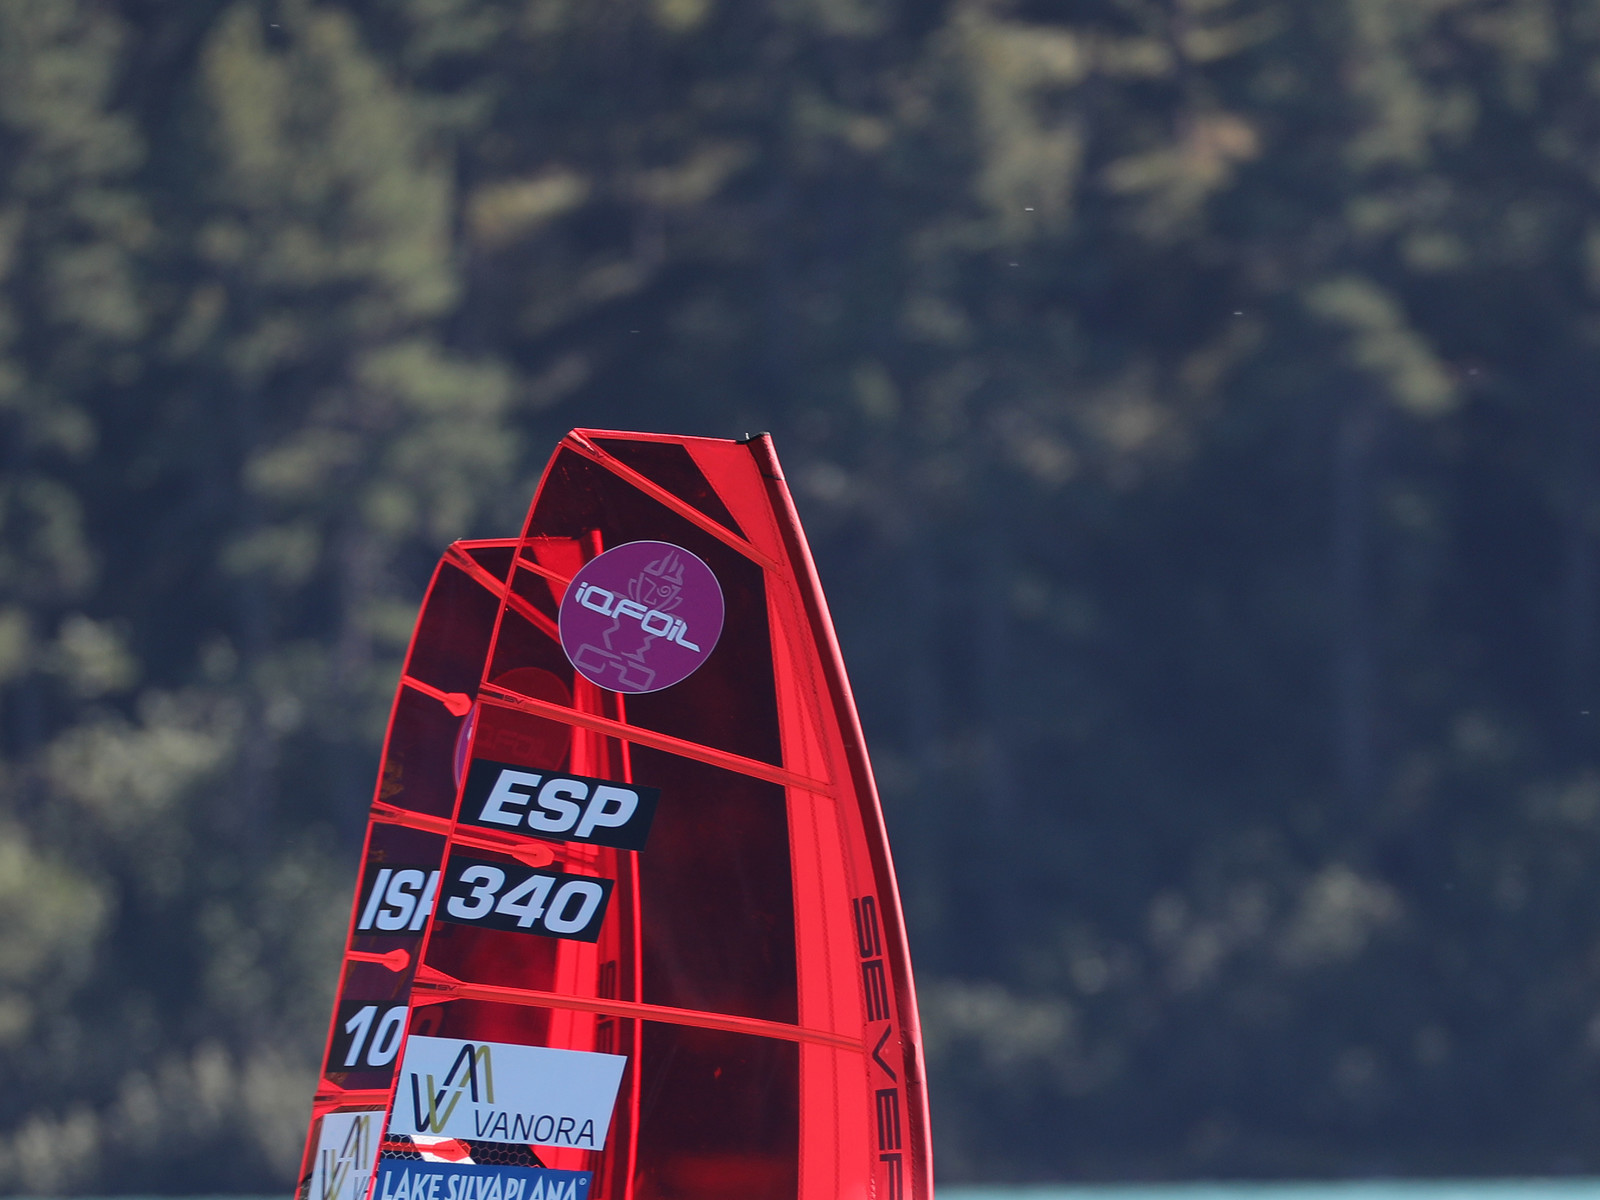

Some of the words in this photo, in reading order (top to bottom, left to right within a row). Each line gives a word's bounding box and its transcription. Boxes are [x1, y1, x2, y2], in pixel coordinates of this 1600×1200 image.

[478, 769, 640, 838] ESP
[447, 865, 603, 935] 340
[474, 1109, 595, 1147] VANORA
